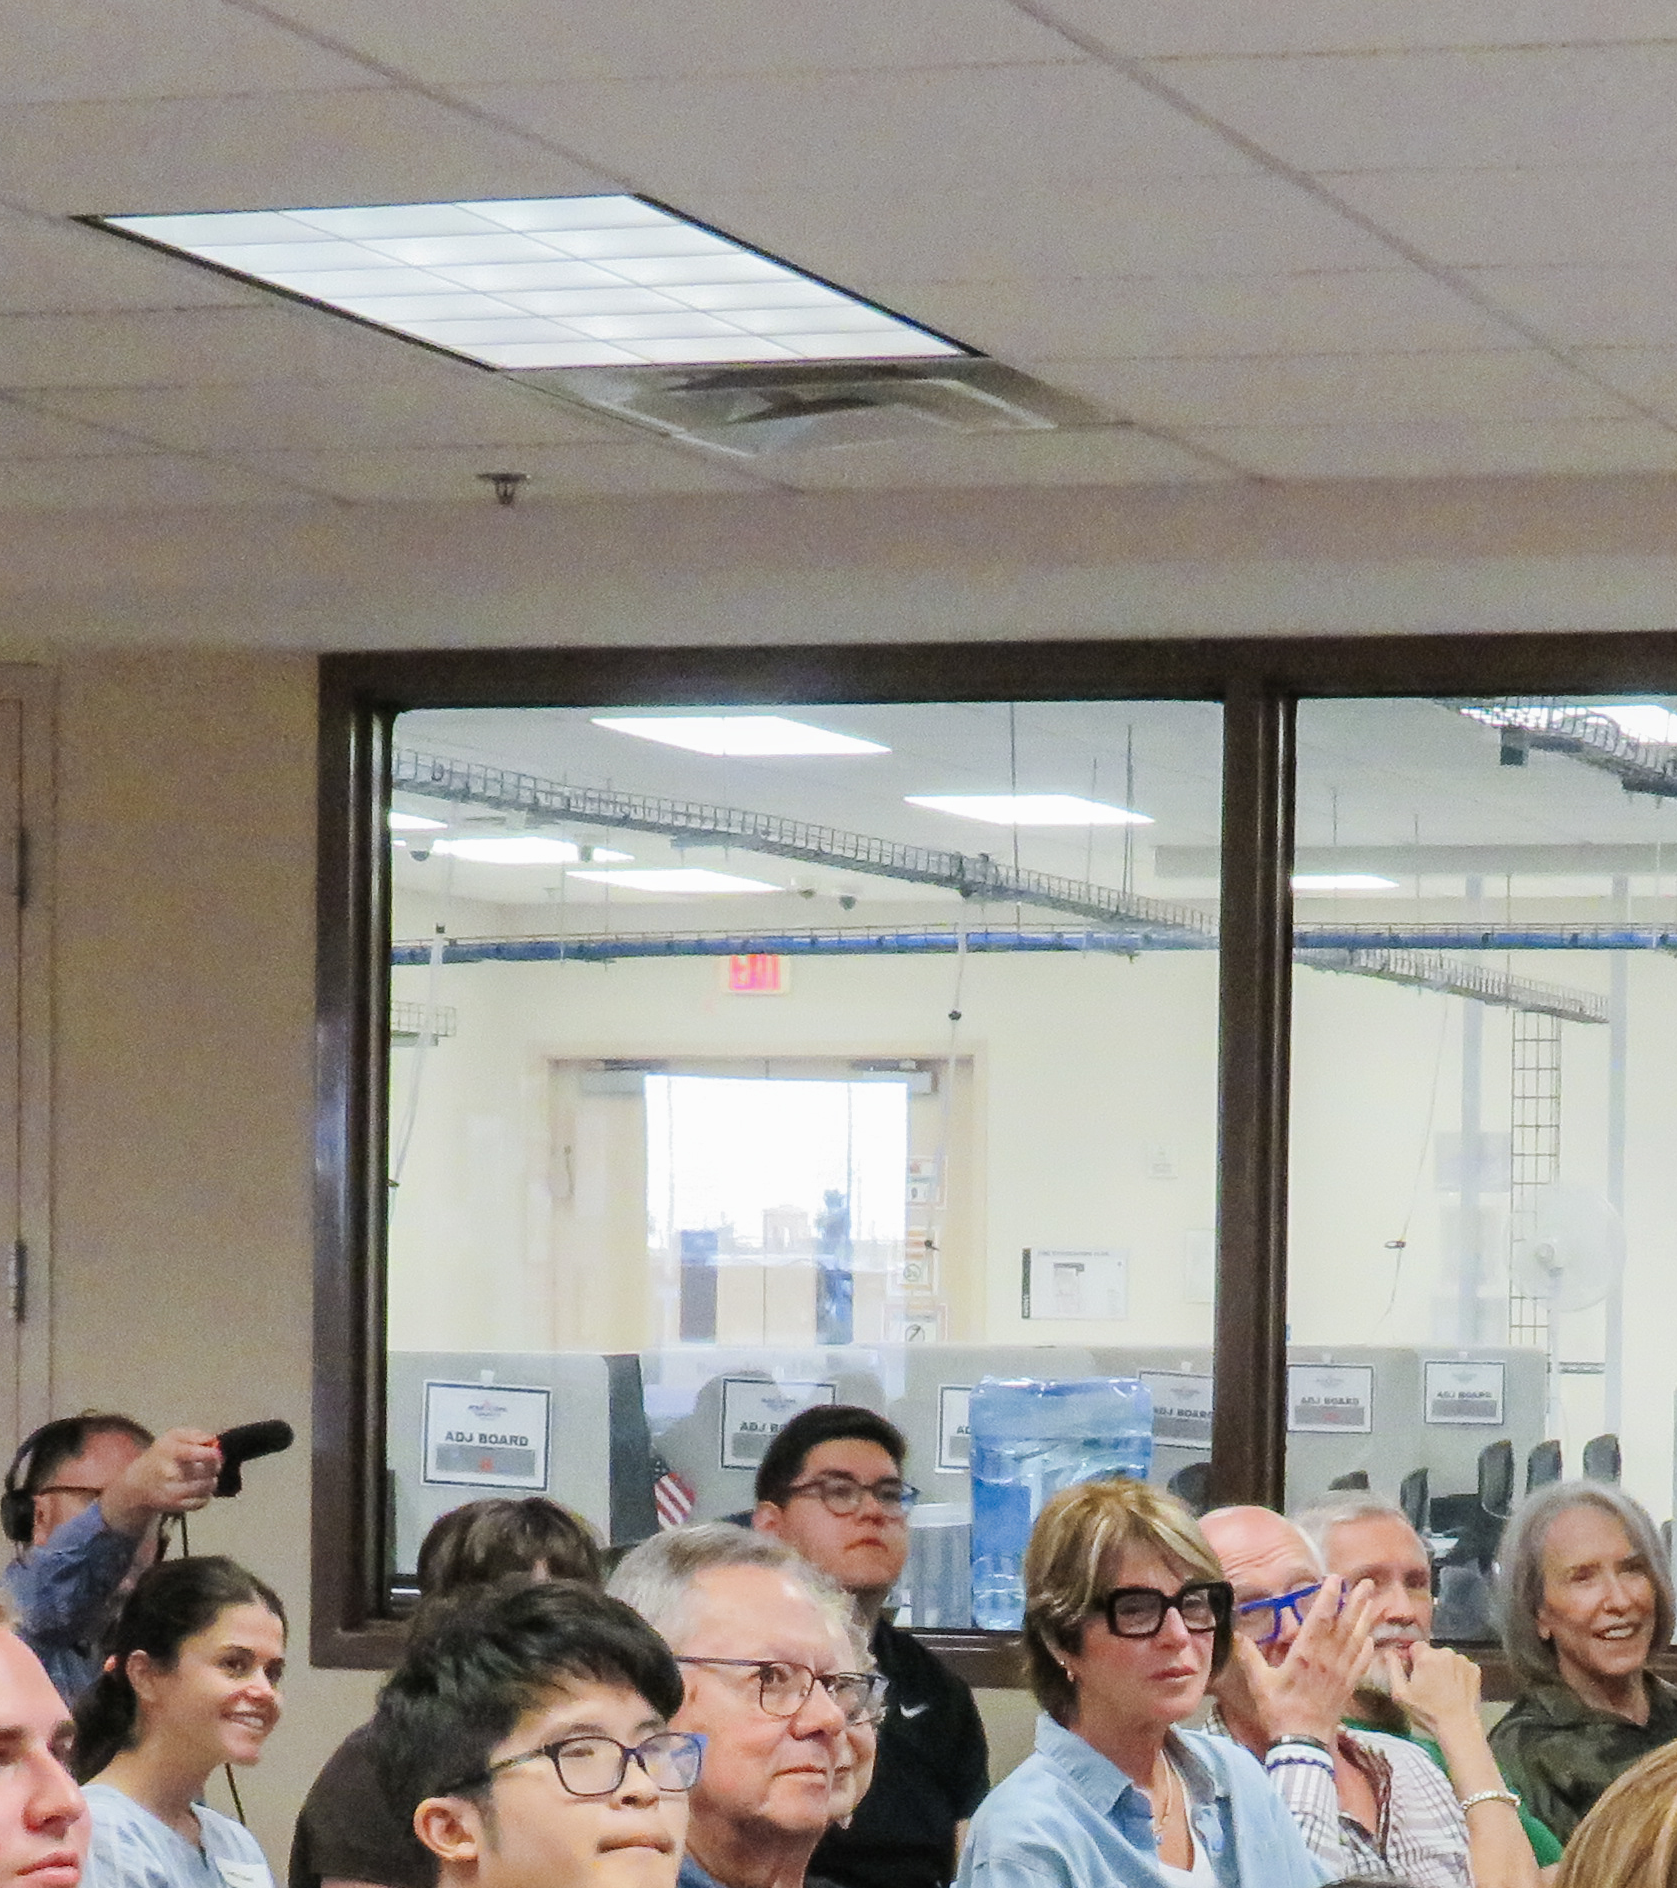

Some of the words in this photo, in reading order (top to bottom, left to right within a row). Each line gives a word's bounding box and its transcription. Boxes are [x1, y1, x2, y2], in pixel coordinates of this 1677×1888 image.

[739, 1421, 766, 1433] ADJ
[445, 1431, 474, 1443] ADJ
[479, 1433, 529, 1447] BOARD
